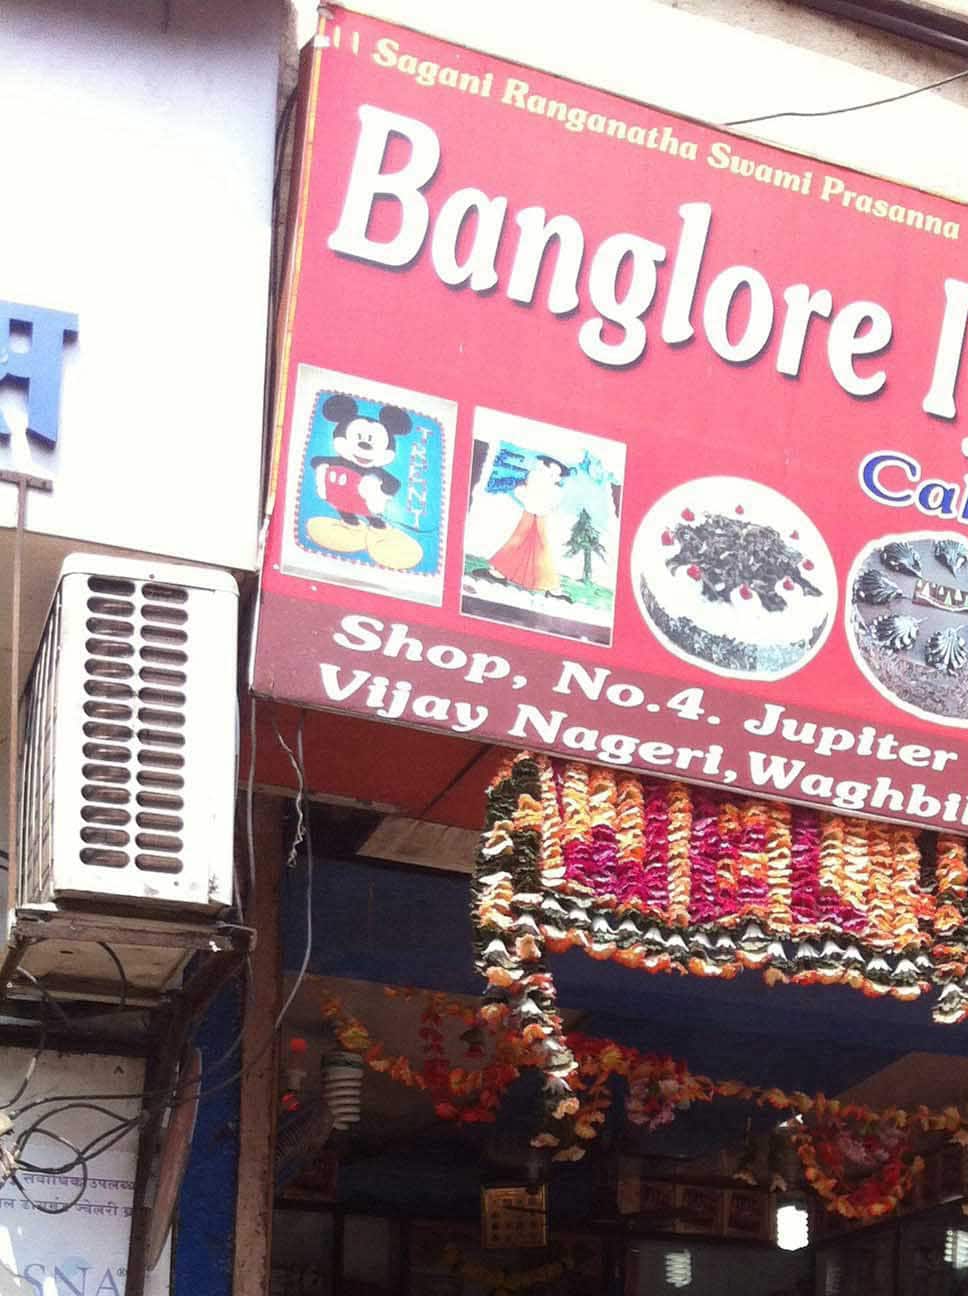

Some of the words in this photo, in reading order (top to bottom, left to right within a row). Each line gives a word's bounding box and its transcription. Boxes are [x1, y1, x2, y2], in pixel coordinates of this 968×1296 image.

[373, 38, 494, 99] Sagani
[501, 79, 698, 161] Ranganatha
[707, 143, 814, 197] Swami
[820, 175, 961, 241] Prasanna
[328, 103, 894, 398] Banglore
[317, 662, 491, 732] Vijay
[332, 613, 528, 691] Shop,
[743, 701, 959, 772] Jupiter
